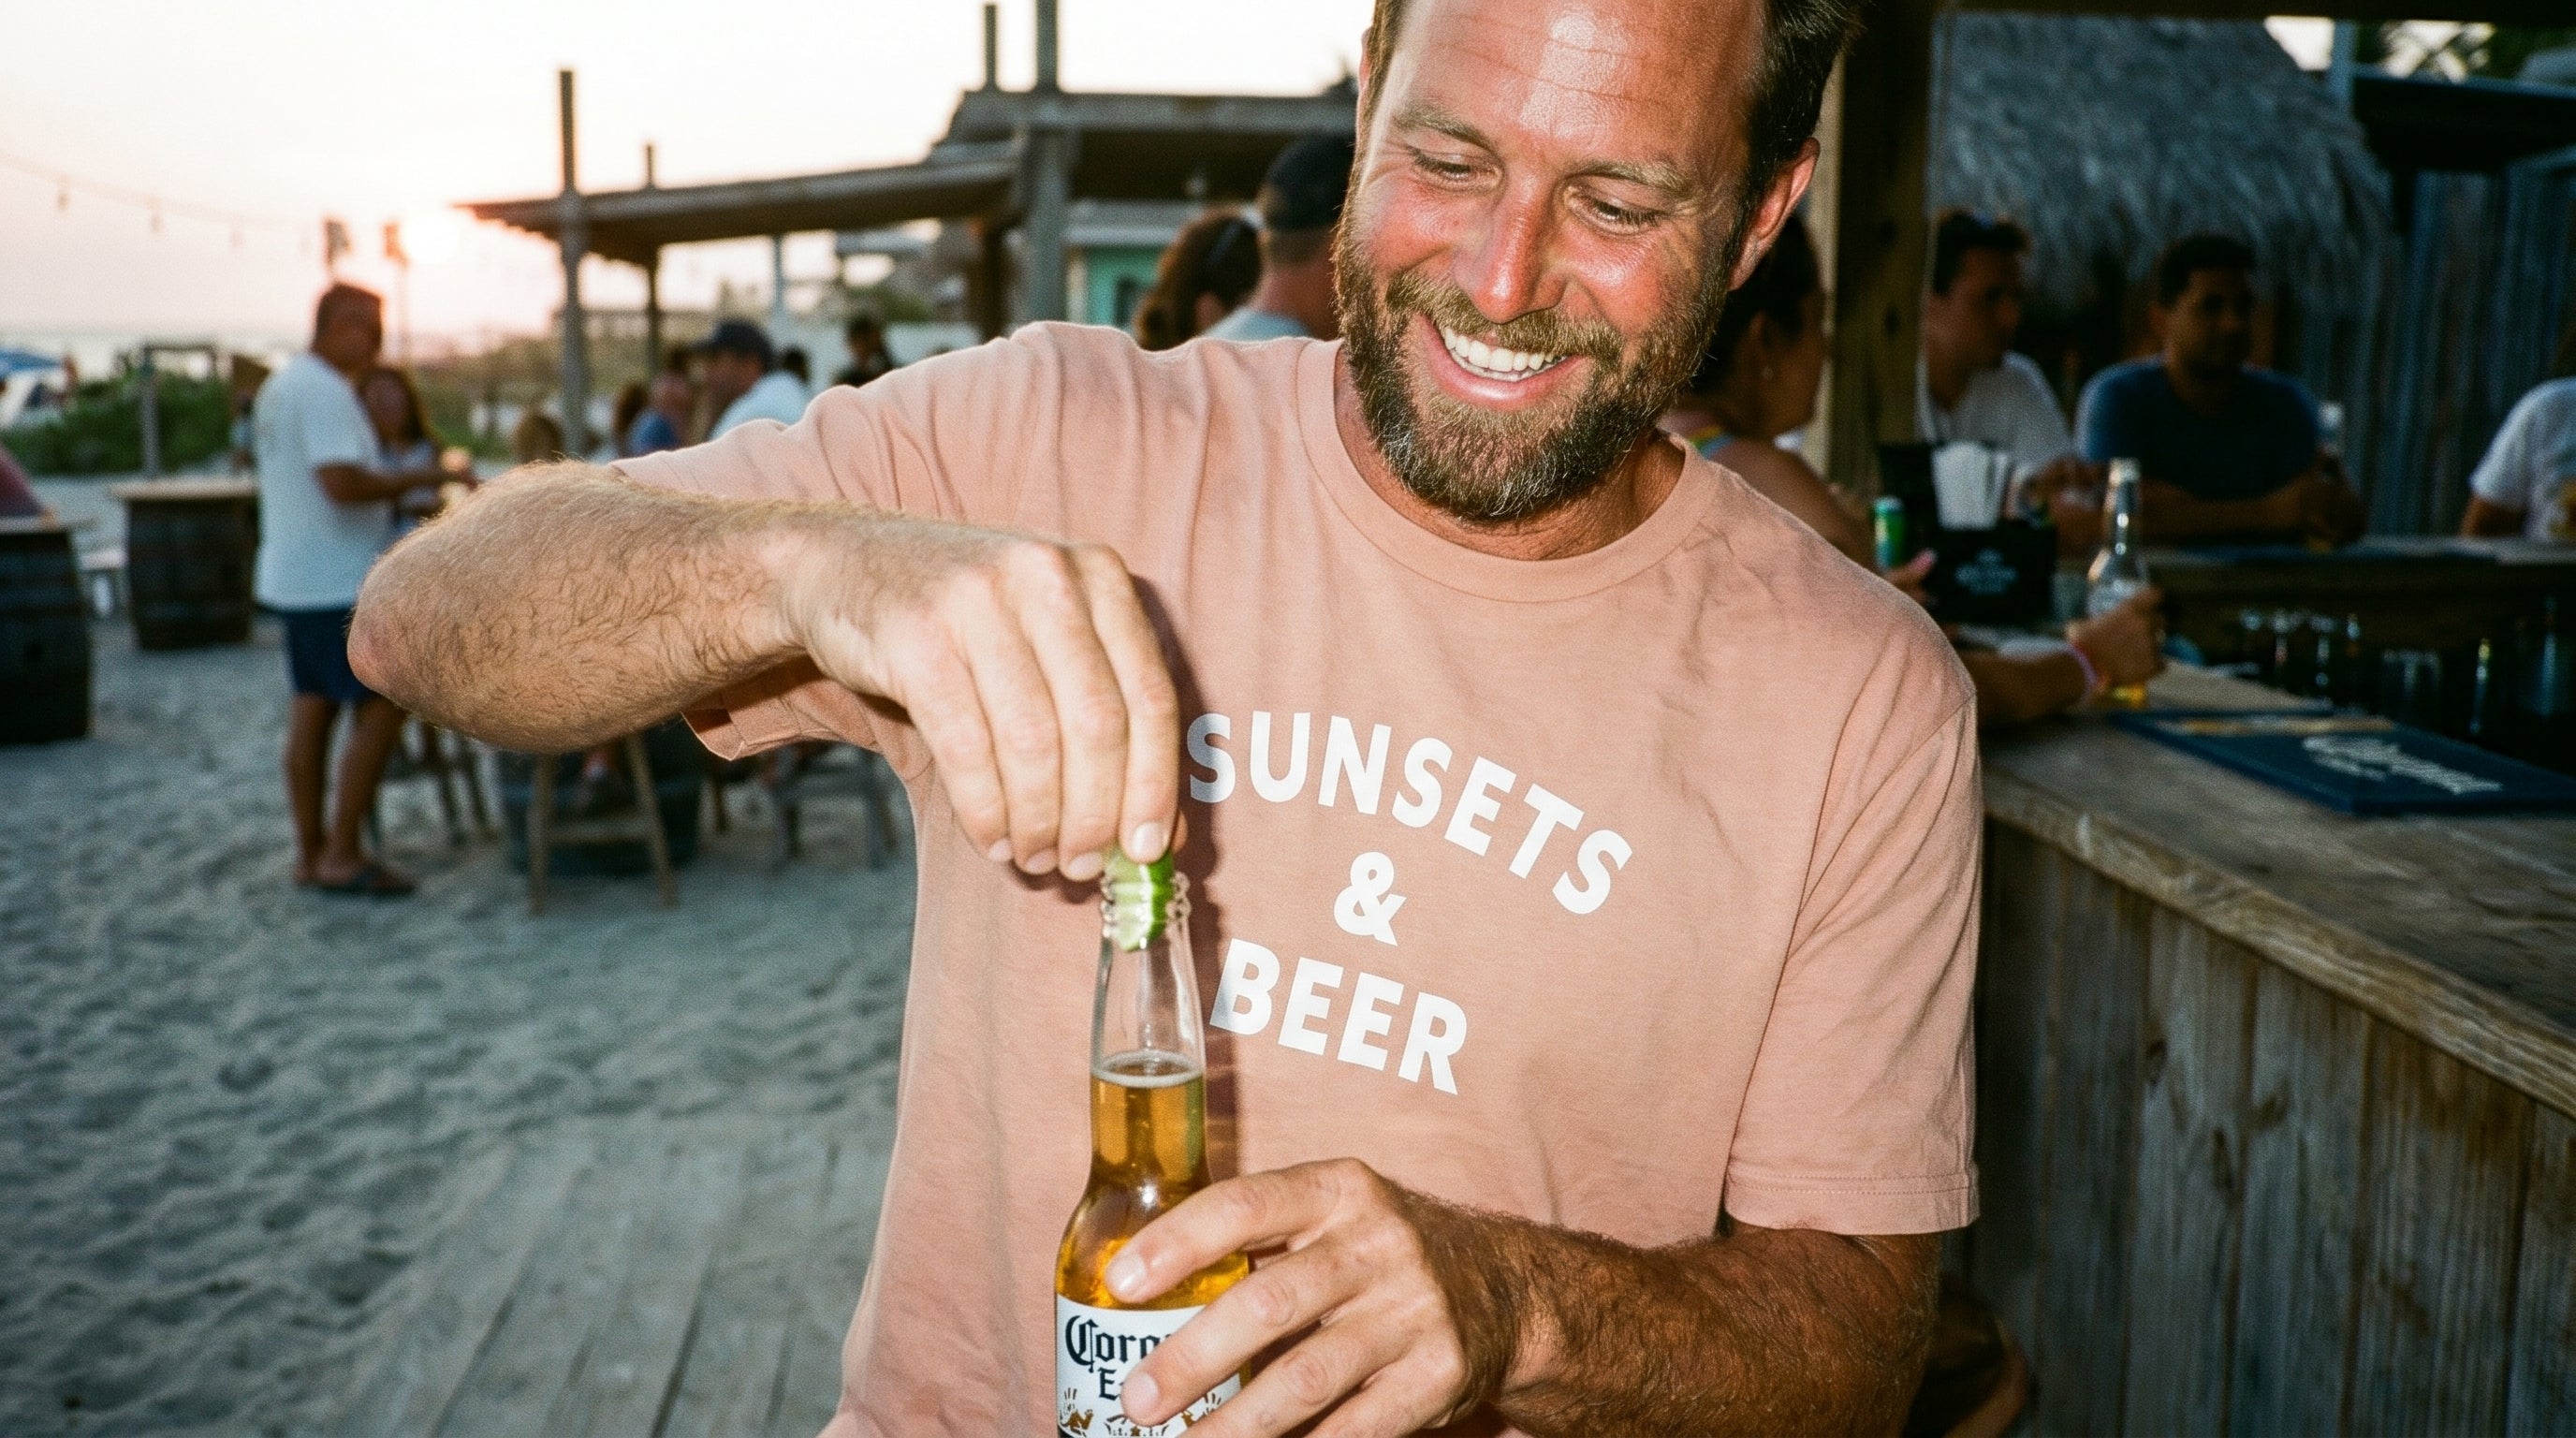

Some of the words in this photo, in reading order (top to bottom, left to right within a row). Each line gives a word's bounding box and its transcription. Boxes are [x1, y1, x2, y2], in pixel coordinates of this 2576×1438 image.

[1187, 711, 1632, 915] SUNSETS
[1334, 851, 1406, 946] &
[1209, 938, 1468, 1095] BEER
[1065, 1315, 1171, 1373] Coro
